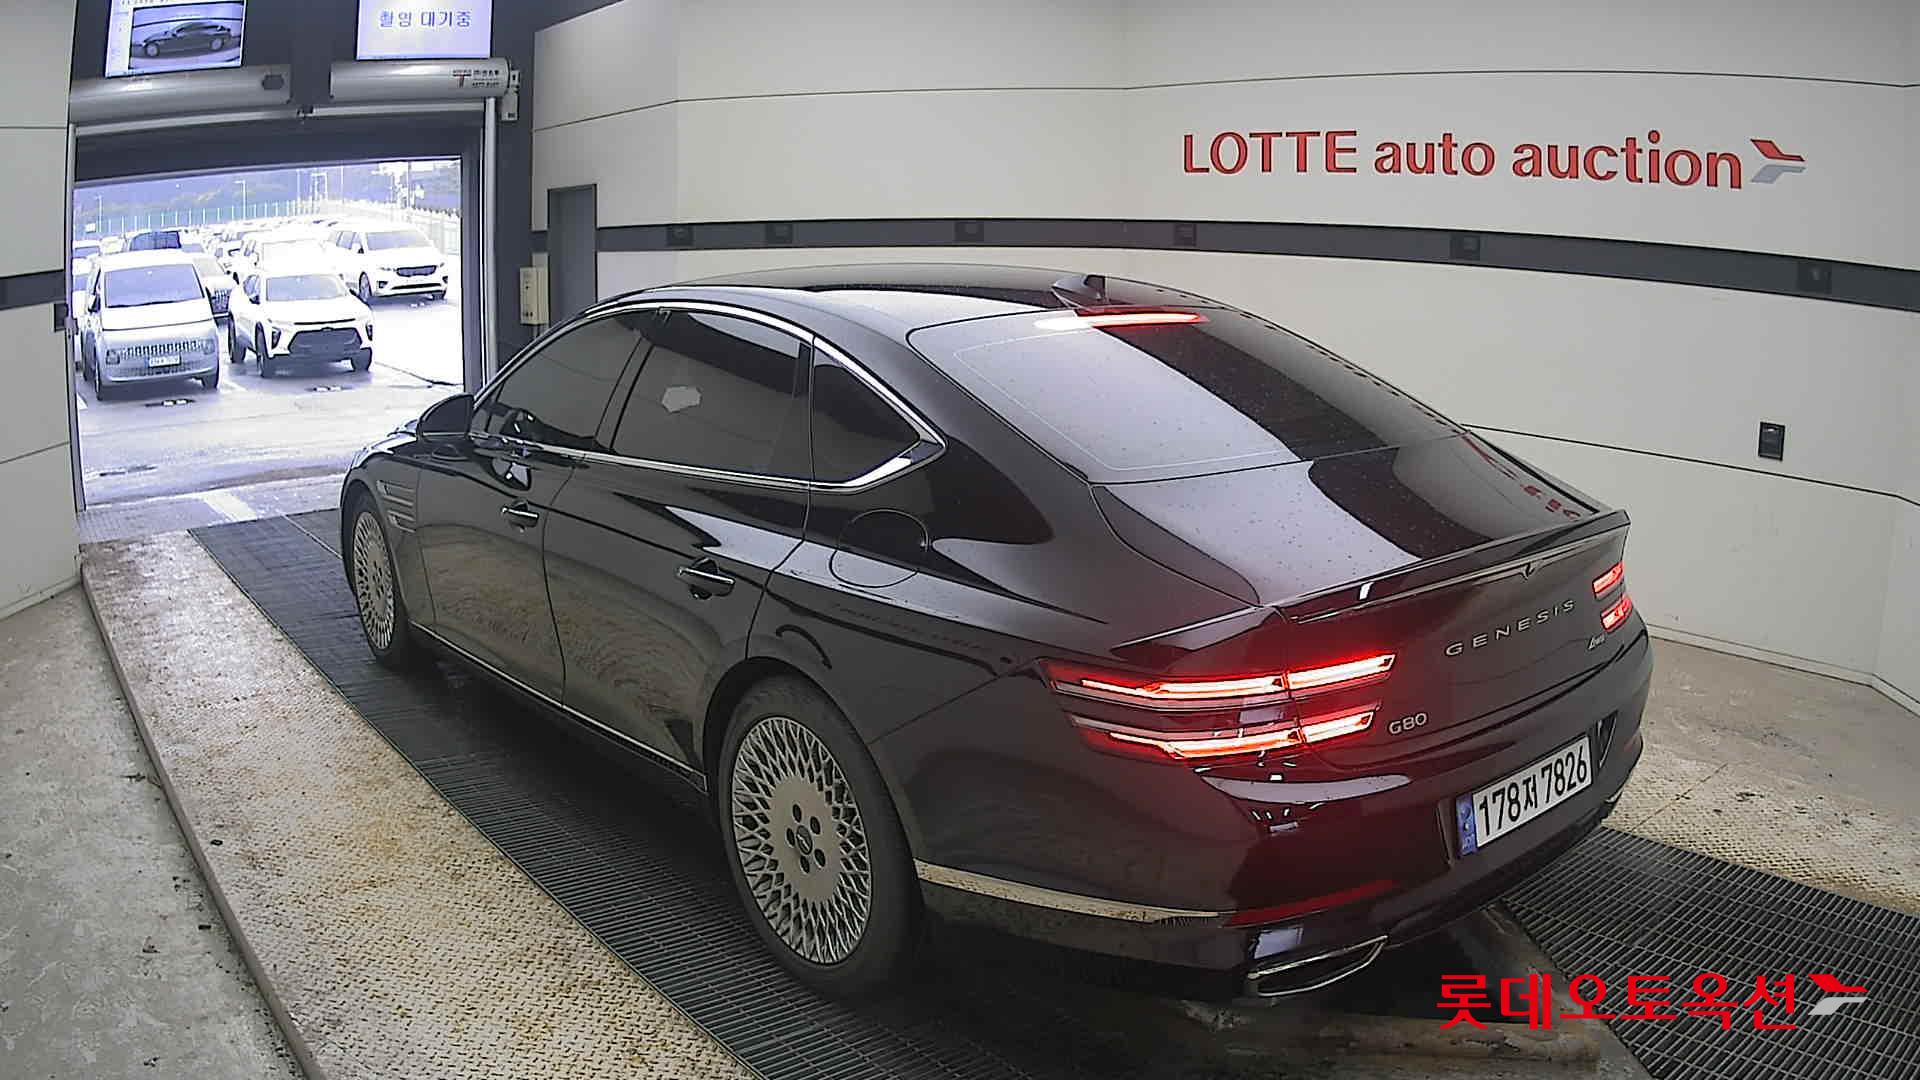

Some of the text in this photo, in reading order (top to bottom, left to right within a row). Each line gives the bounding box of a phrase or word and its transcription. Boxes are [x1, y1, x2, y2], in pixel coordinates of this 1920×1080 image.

[421, 10, 472, 28] 대기중
[1183, 129, 1742, 190] LOTTE auto auction
[1445, 600, 1574, 656] GENESIS
[1389, 712, 1428, 735] G80
